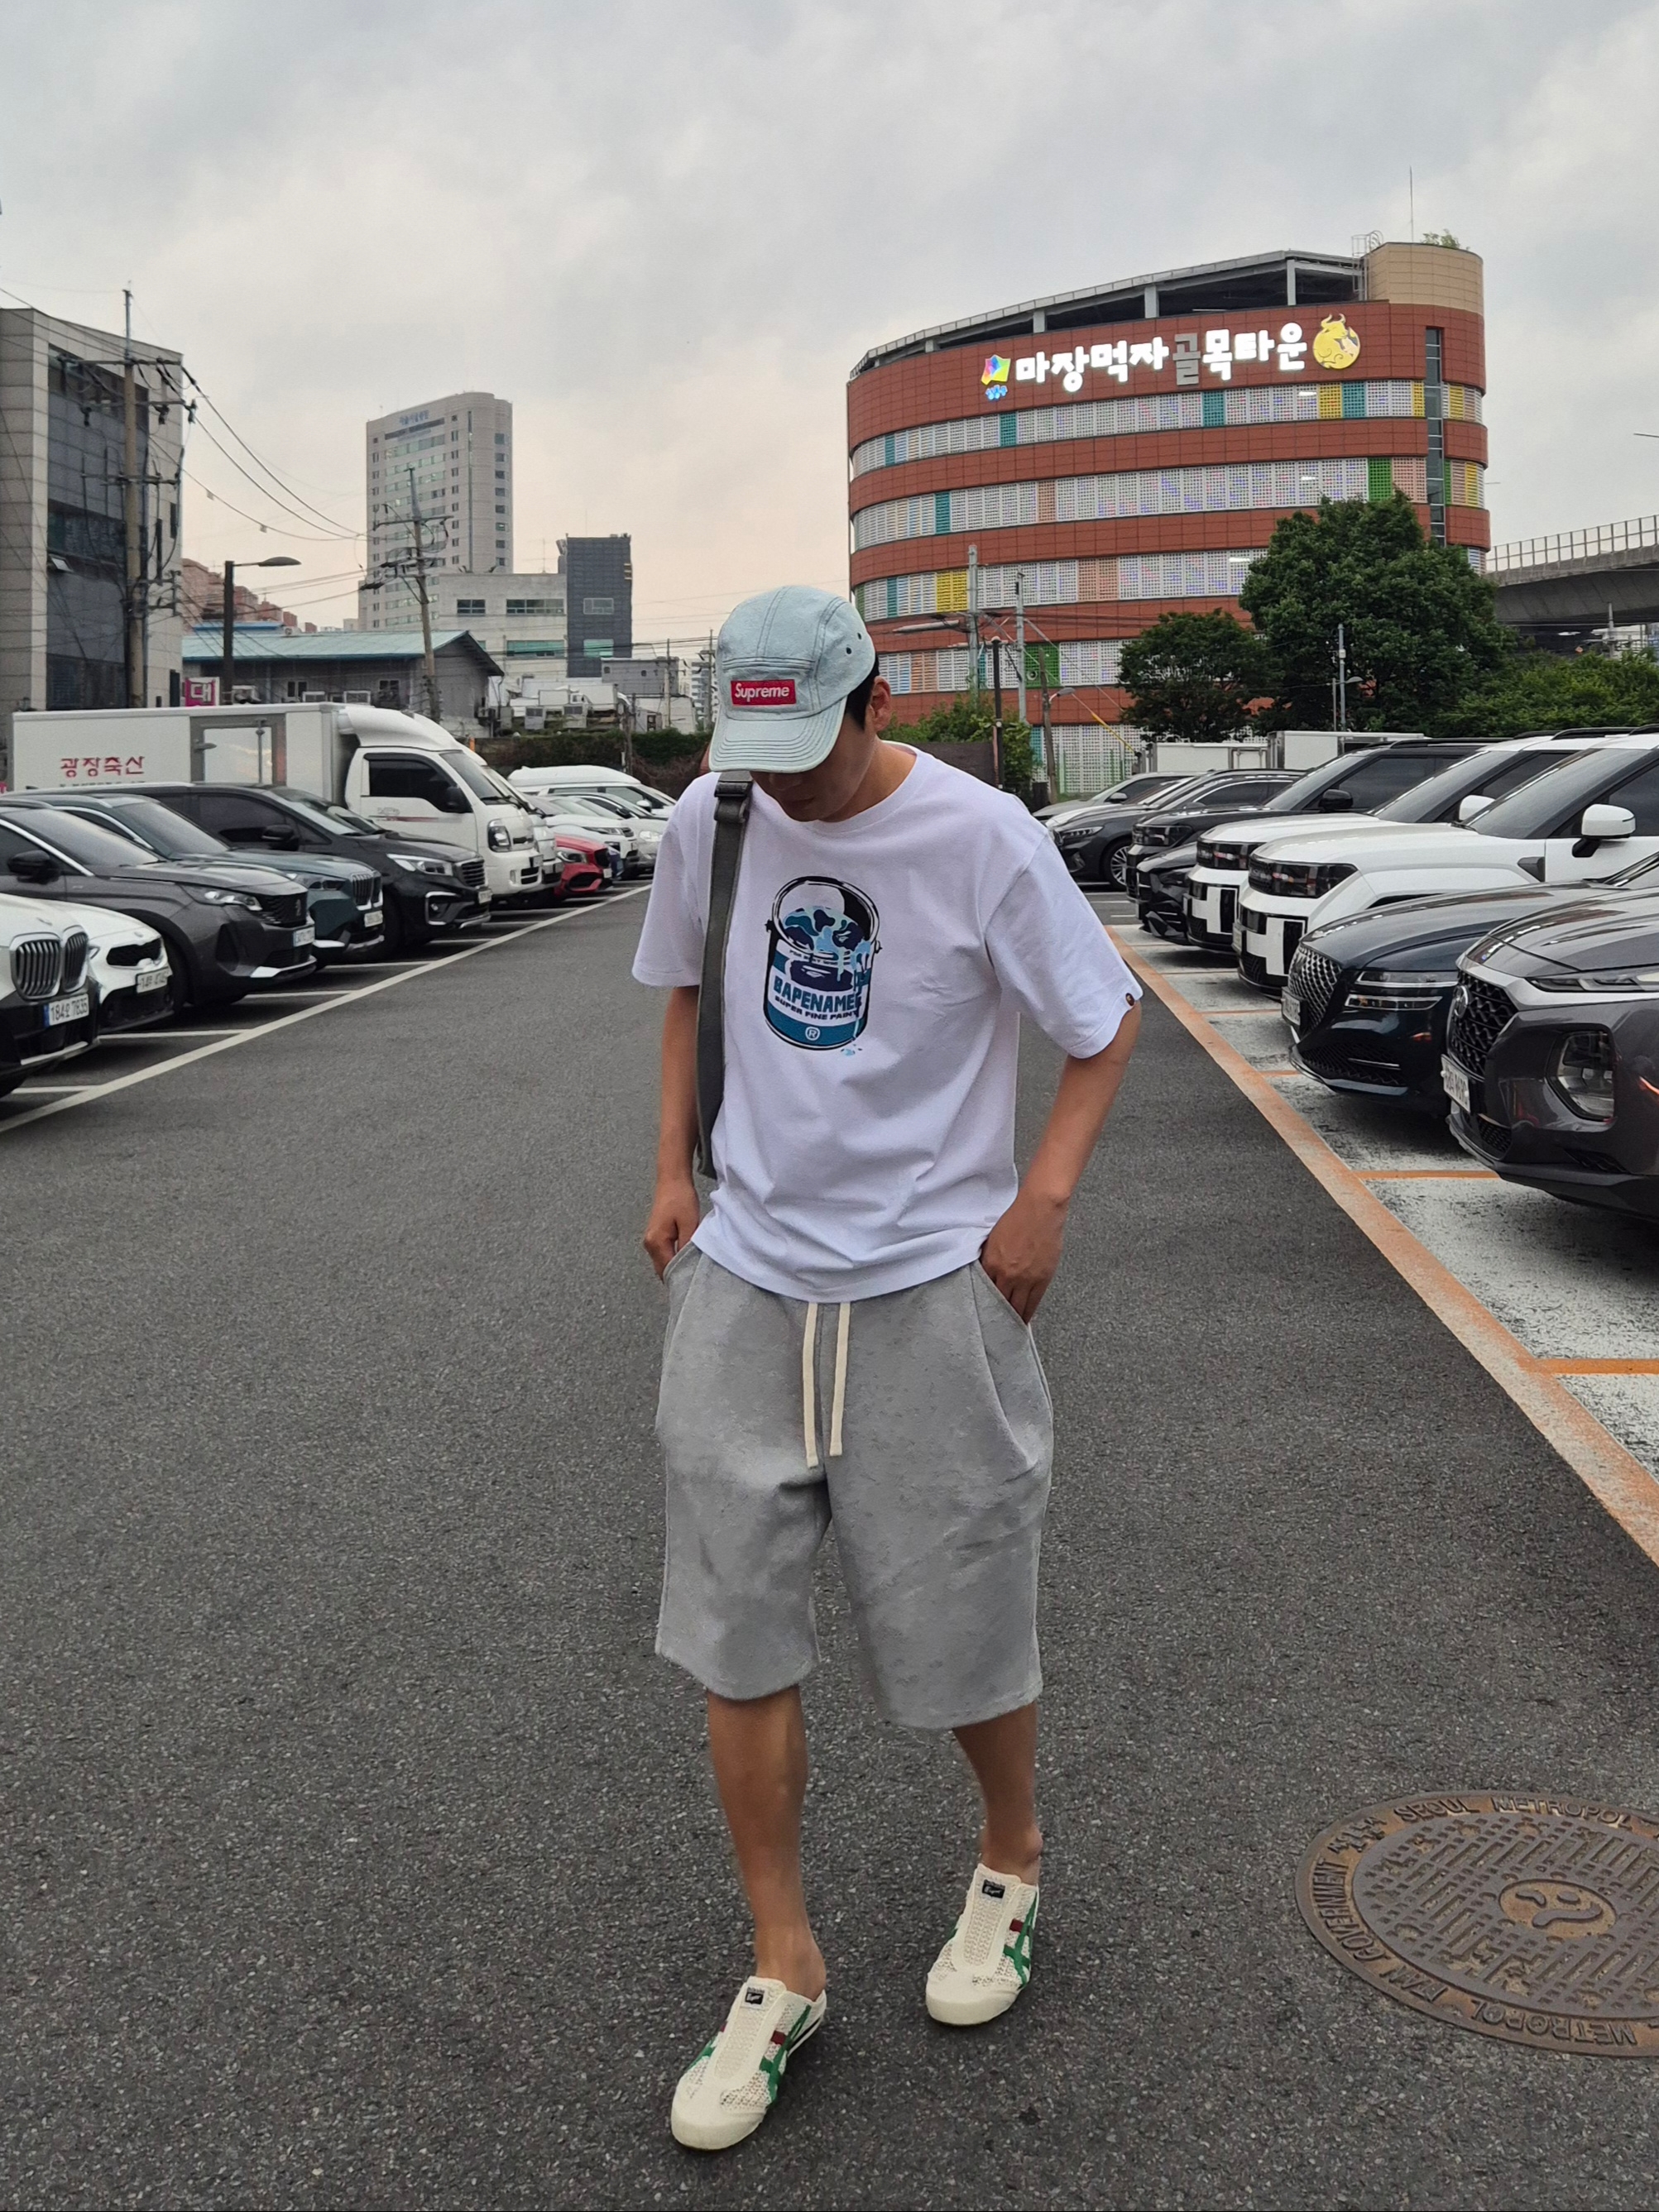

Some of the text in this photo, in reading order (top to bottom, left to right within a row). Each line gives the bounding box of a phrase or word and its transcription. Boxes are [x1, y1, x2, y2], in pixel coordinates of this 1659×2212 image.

[734, 682, 789, 702] Supreme
[60, 756, 145, 778] 광장축산
[774, 995, 803, 1015] SUPER
[805, 1011, 828, 1020] FINE
[1393, 1798, 1479, 1822] SEOUL
[1312, 1858, 1391, 1962] GOVERNMENT
